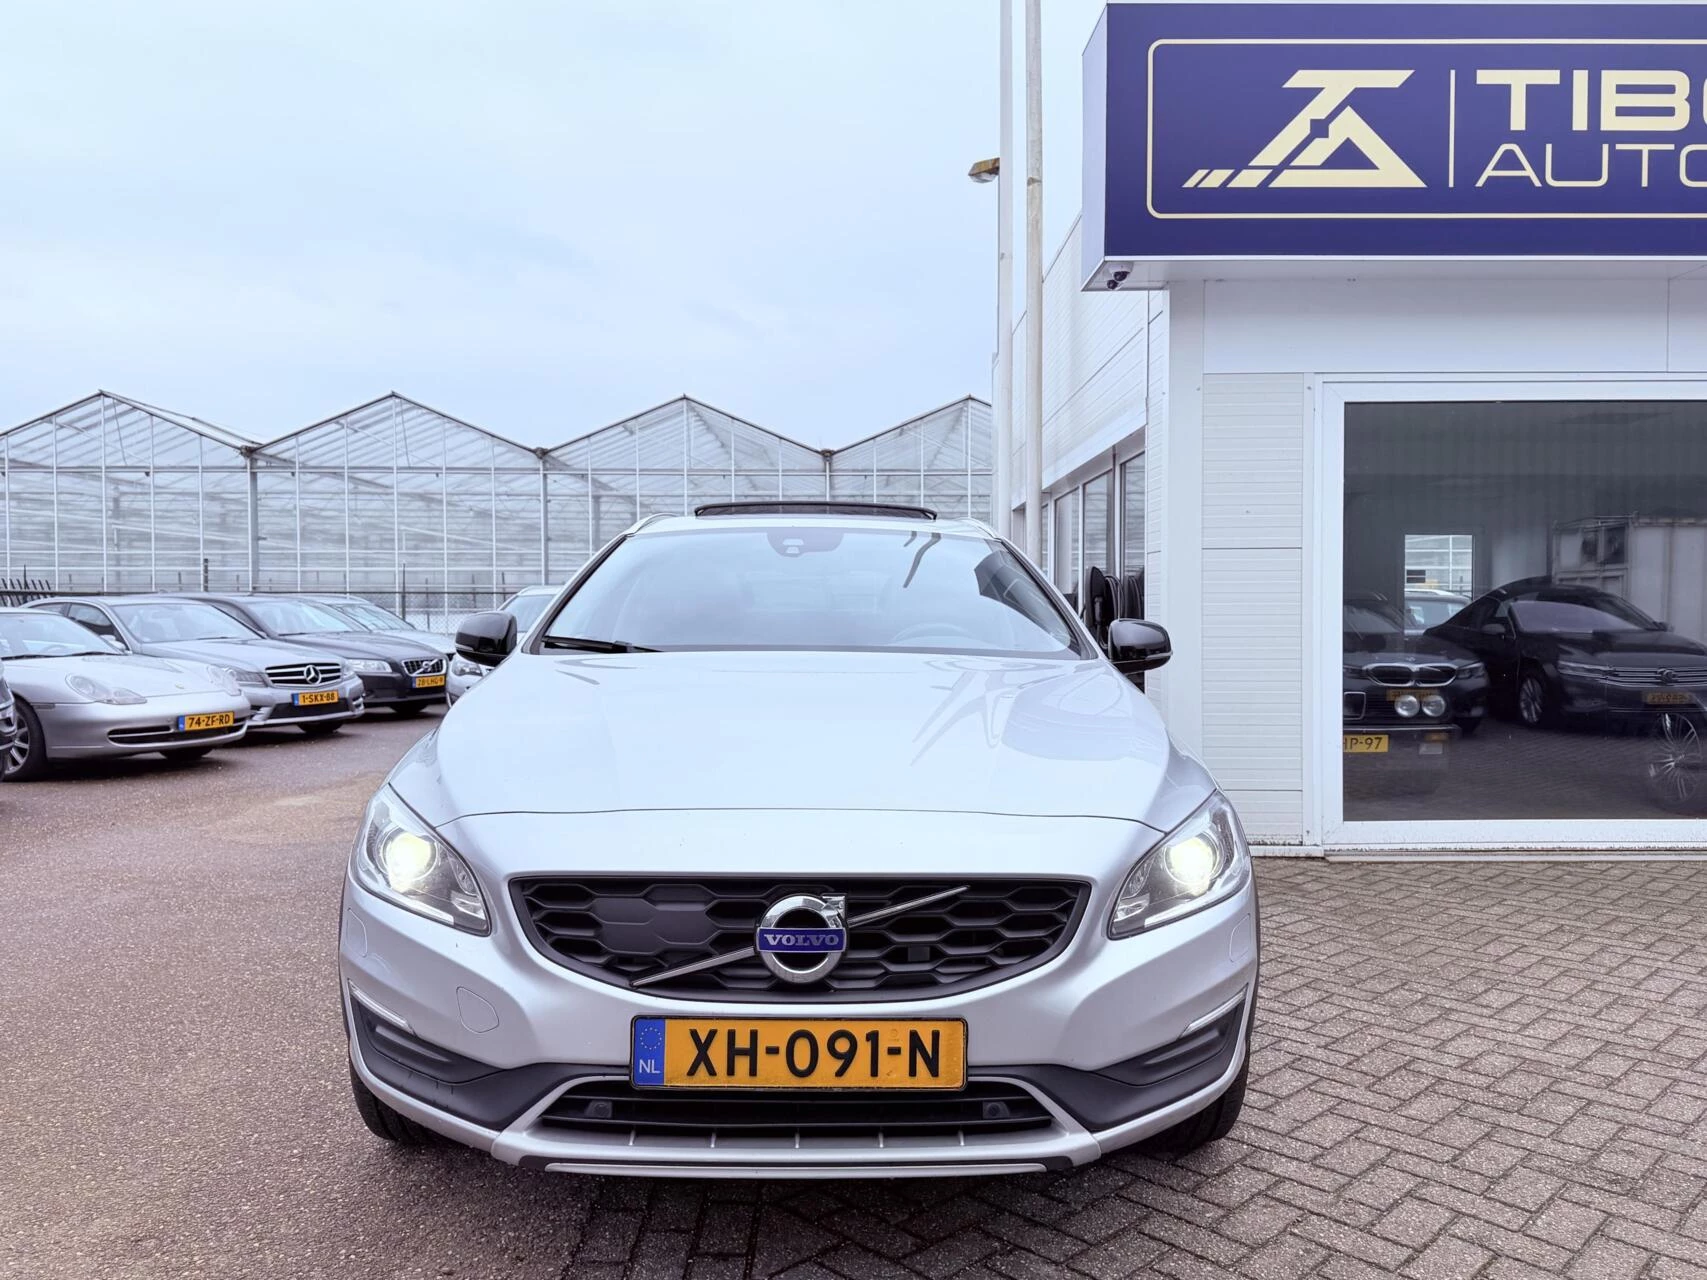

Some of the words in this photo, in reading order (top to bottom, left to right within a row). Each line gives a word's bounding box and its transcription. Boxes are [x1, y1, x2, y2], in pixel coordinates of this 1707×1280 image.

[1476, 69, 1707, 131] TIB
[188, 713, 231, 729] 74-ZF-RD
[763, 934, 840, 947] VOLVO
[686, 1028, 941, 1078] XH-091-N
[639, 1059, 661, 1074] NL
